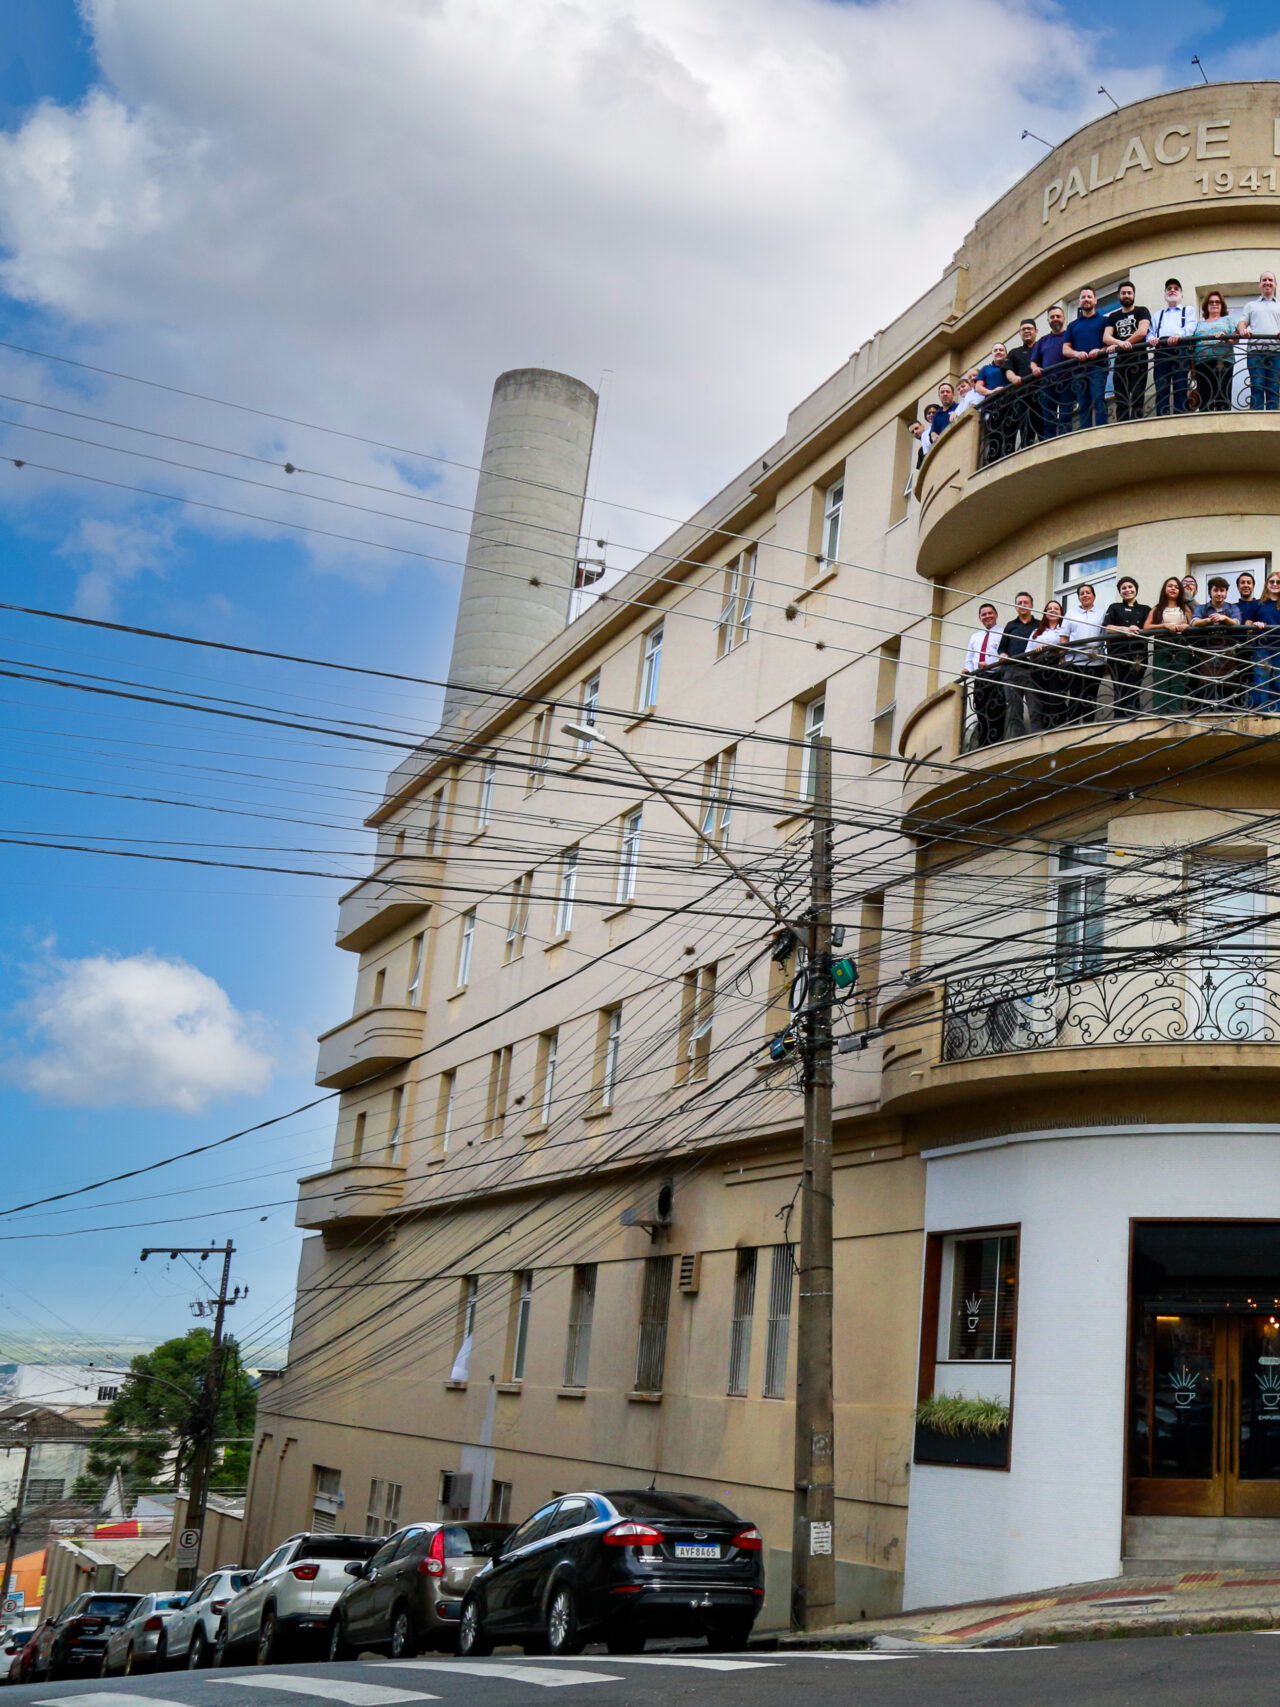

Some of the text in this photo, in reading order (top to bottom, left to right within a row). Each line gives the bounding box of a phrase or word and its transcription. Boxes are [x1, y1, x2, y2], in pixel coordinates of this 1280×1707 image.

[1042, 119, 1231, 224] PALACE
[1195, 167, 1277, 195] 1941
[185, 1533, 194, 1545] E
[680, 1547, 716, 1558] AYF8A65
